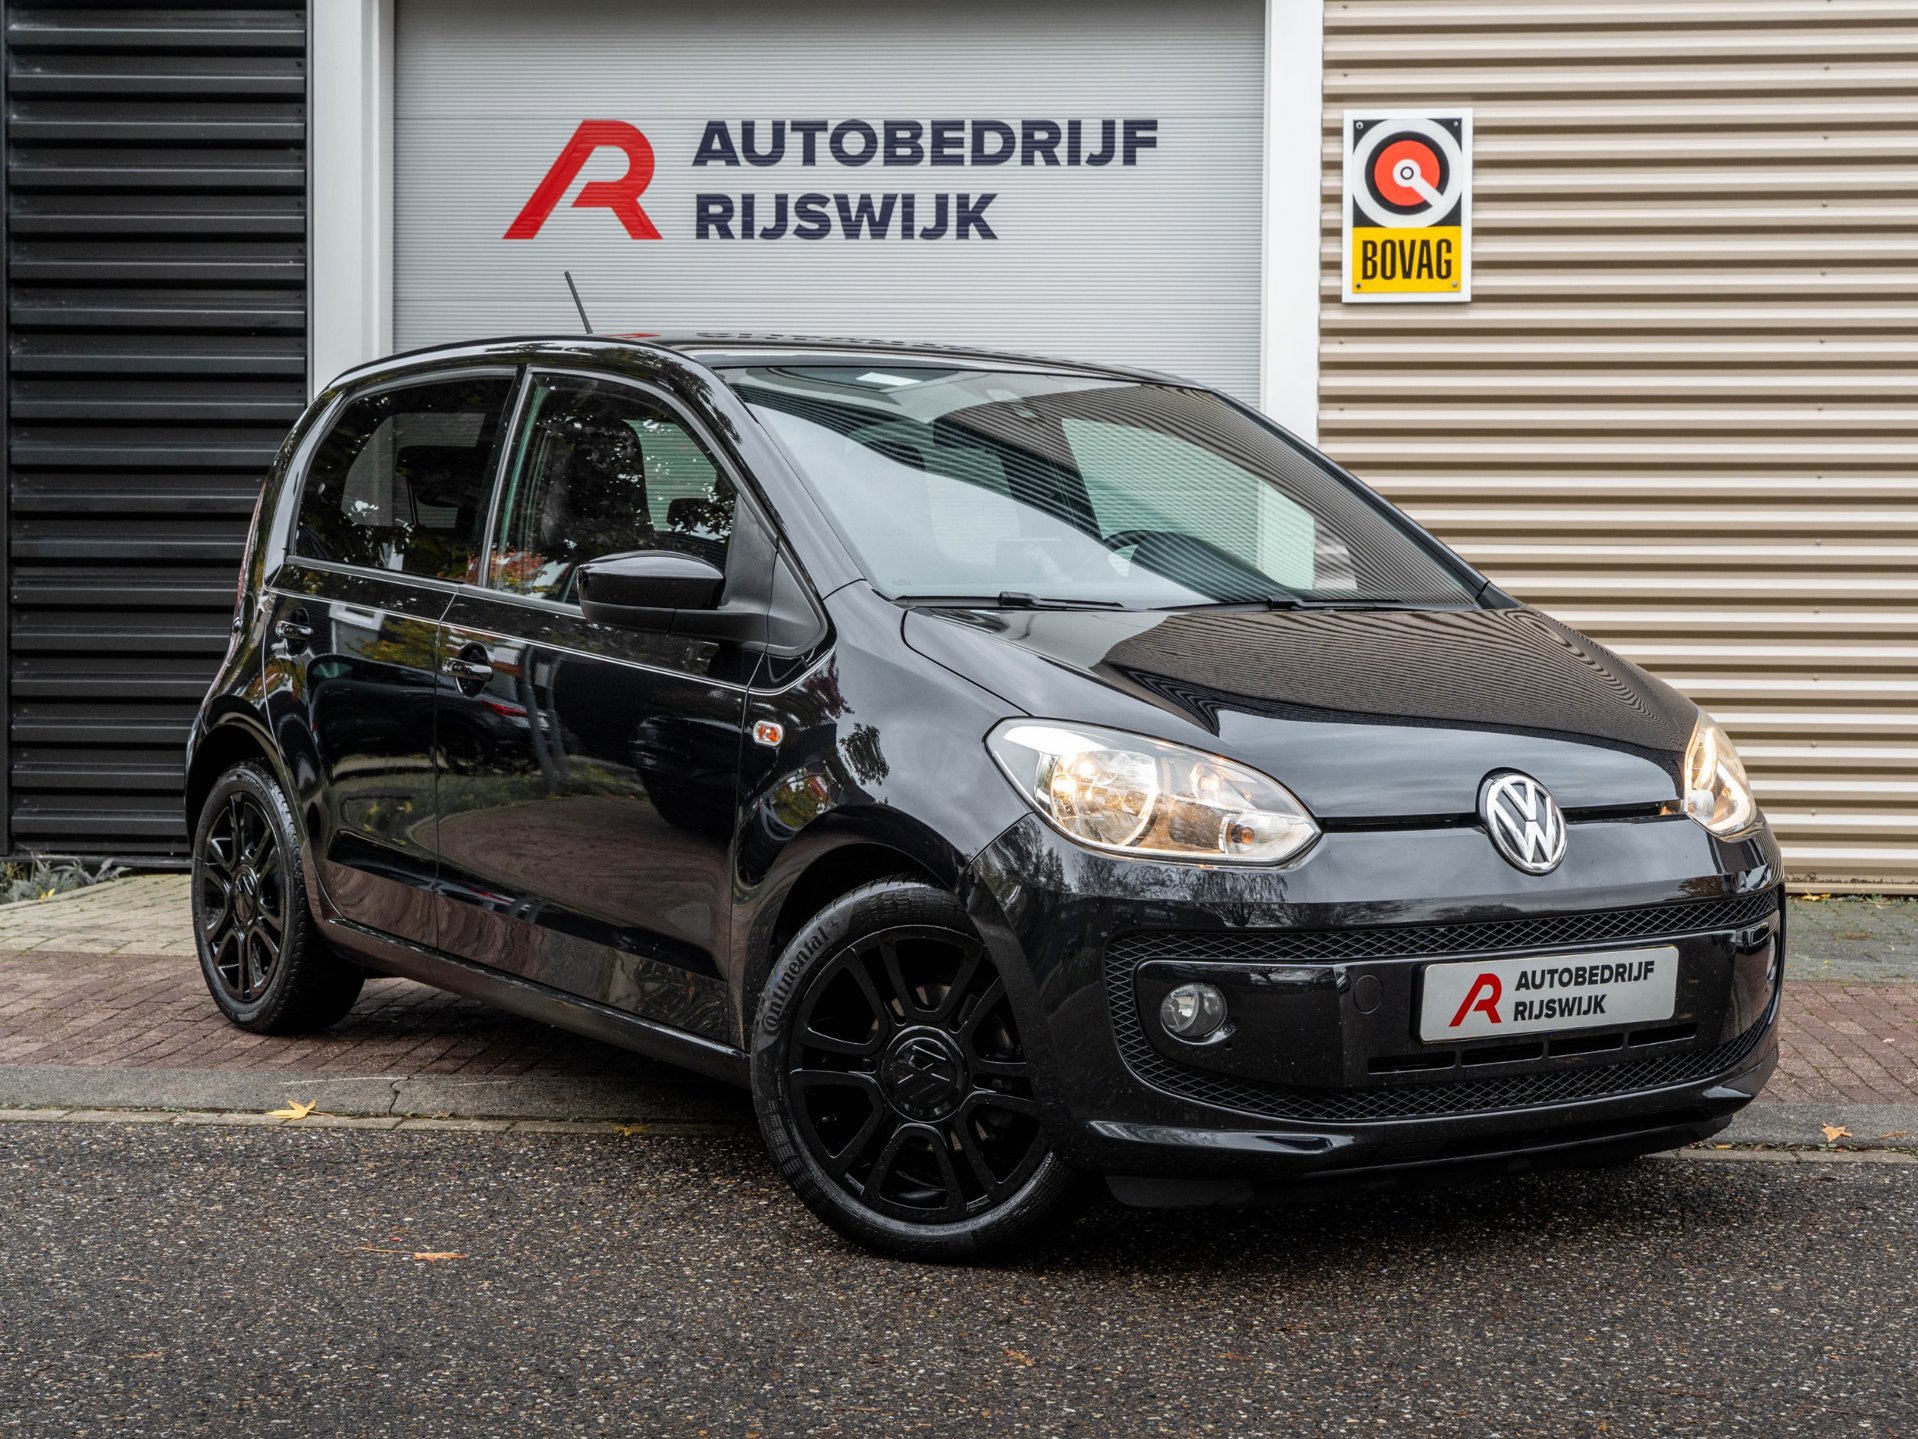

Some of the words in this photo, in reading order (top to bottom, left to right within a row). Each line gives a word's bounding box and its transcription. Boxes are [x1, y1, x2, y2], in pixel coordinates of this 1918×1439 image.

[693, 119, 1158, 166] AUTOBEDRIJF
[695, 193, 998, 240] RIJSWIJK
[1361, 238, 1452, 281] BOVAG
[1514, 960, 1655, 992] AUTOBEDRIJF
[1513, 993, 1607, 1022] RIJSWIJK
